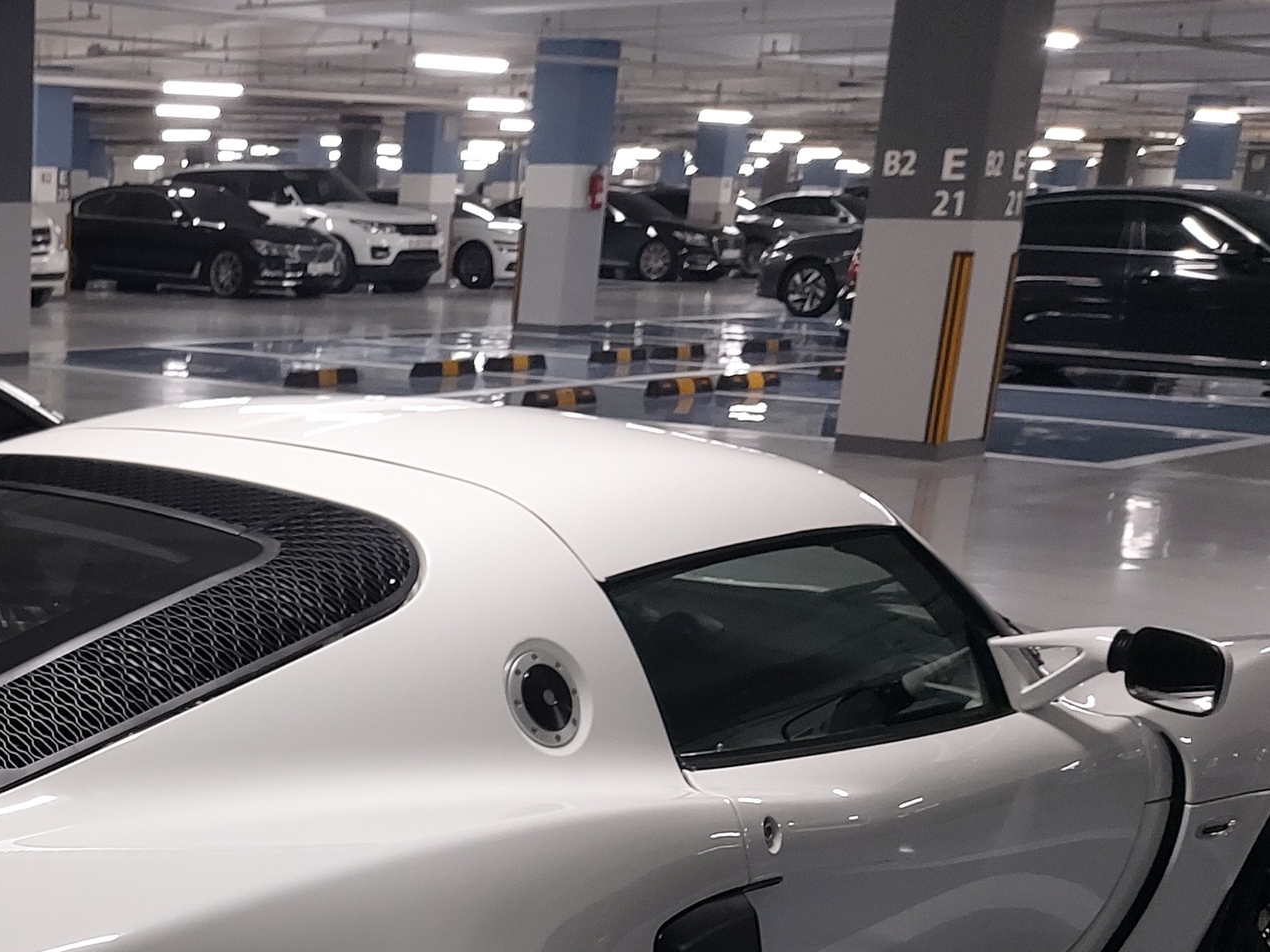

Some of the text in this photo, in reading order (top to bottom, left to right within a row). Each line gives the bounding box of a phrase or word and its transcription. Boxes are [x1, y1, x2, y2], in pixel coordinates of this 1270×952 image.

[882, 147, 969, 181] B2 E
[985, 149, 1028, 181] B2 E
[931, 189, 966, 217] 21
[1004, 190, 1023, 217] 21
